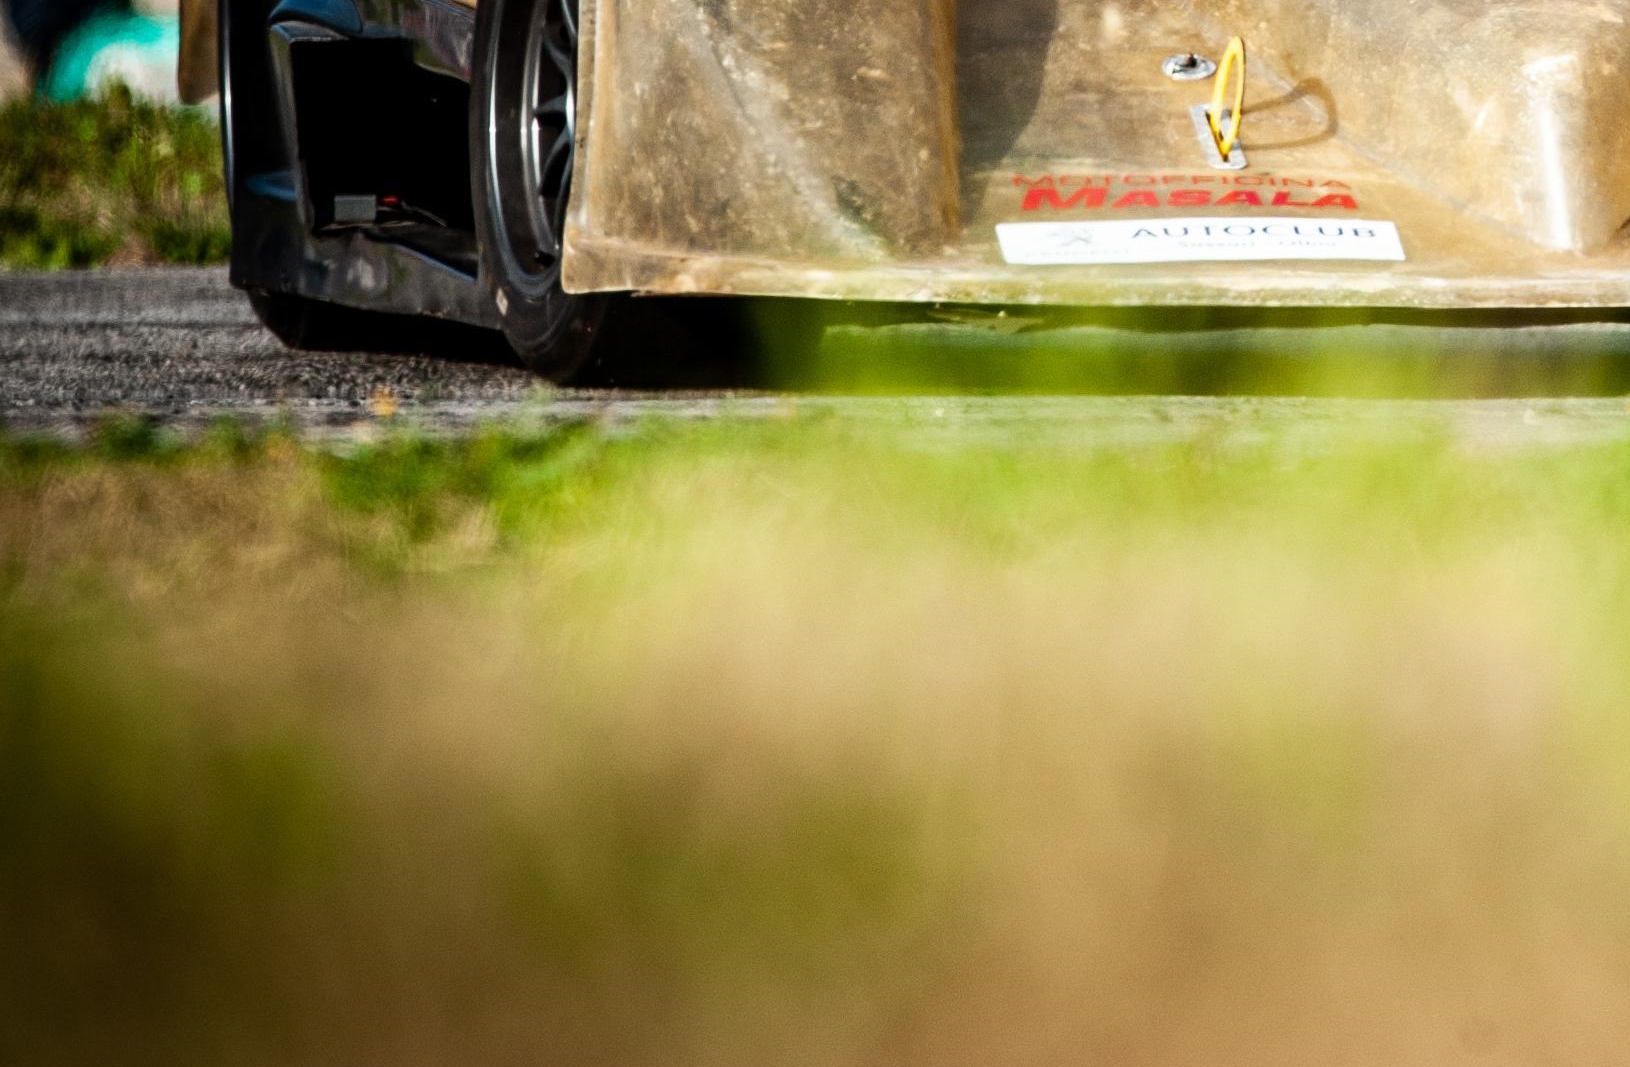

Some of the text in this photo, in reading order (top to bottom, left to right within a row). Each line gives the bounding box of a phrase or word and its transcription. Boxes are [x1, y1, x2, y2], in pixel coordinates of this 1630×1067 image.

[1012, 173, 1353, 189] MOTOFFICINA
[1020, 186, 1359, 211] MASALA
[1131, 223, 1378, 239] AUTOCLUB
